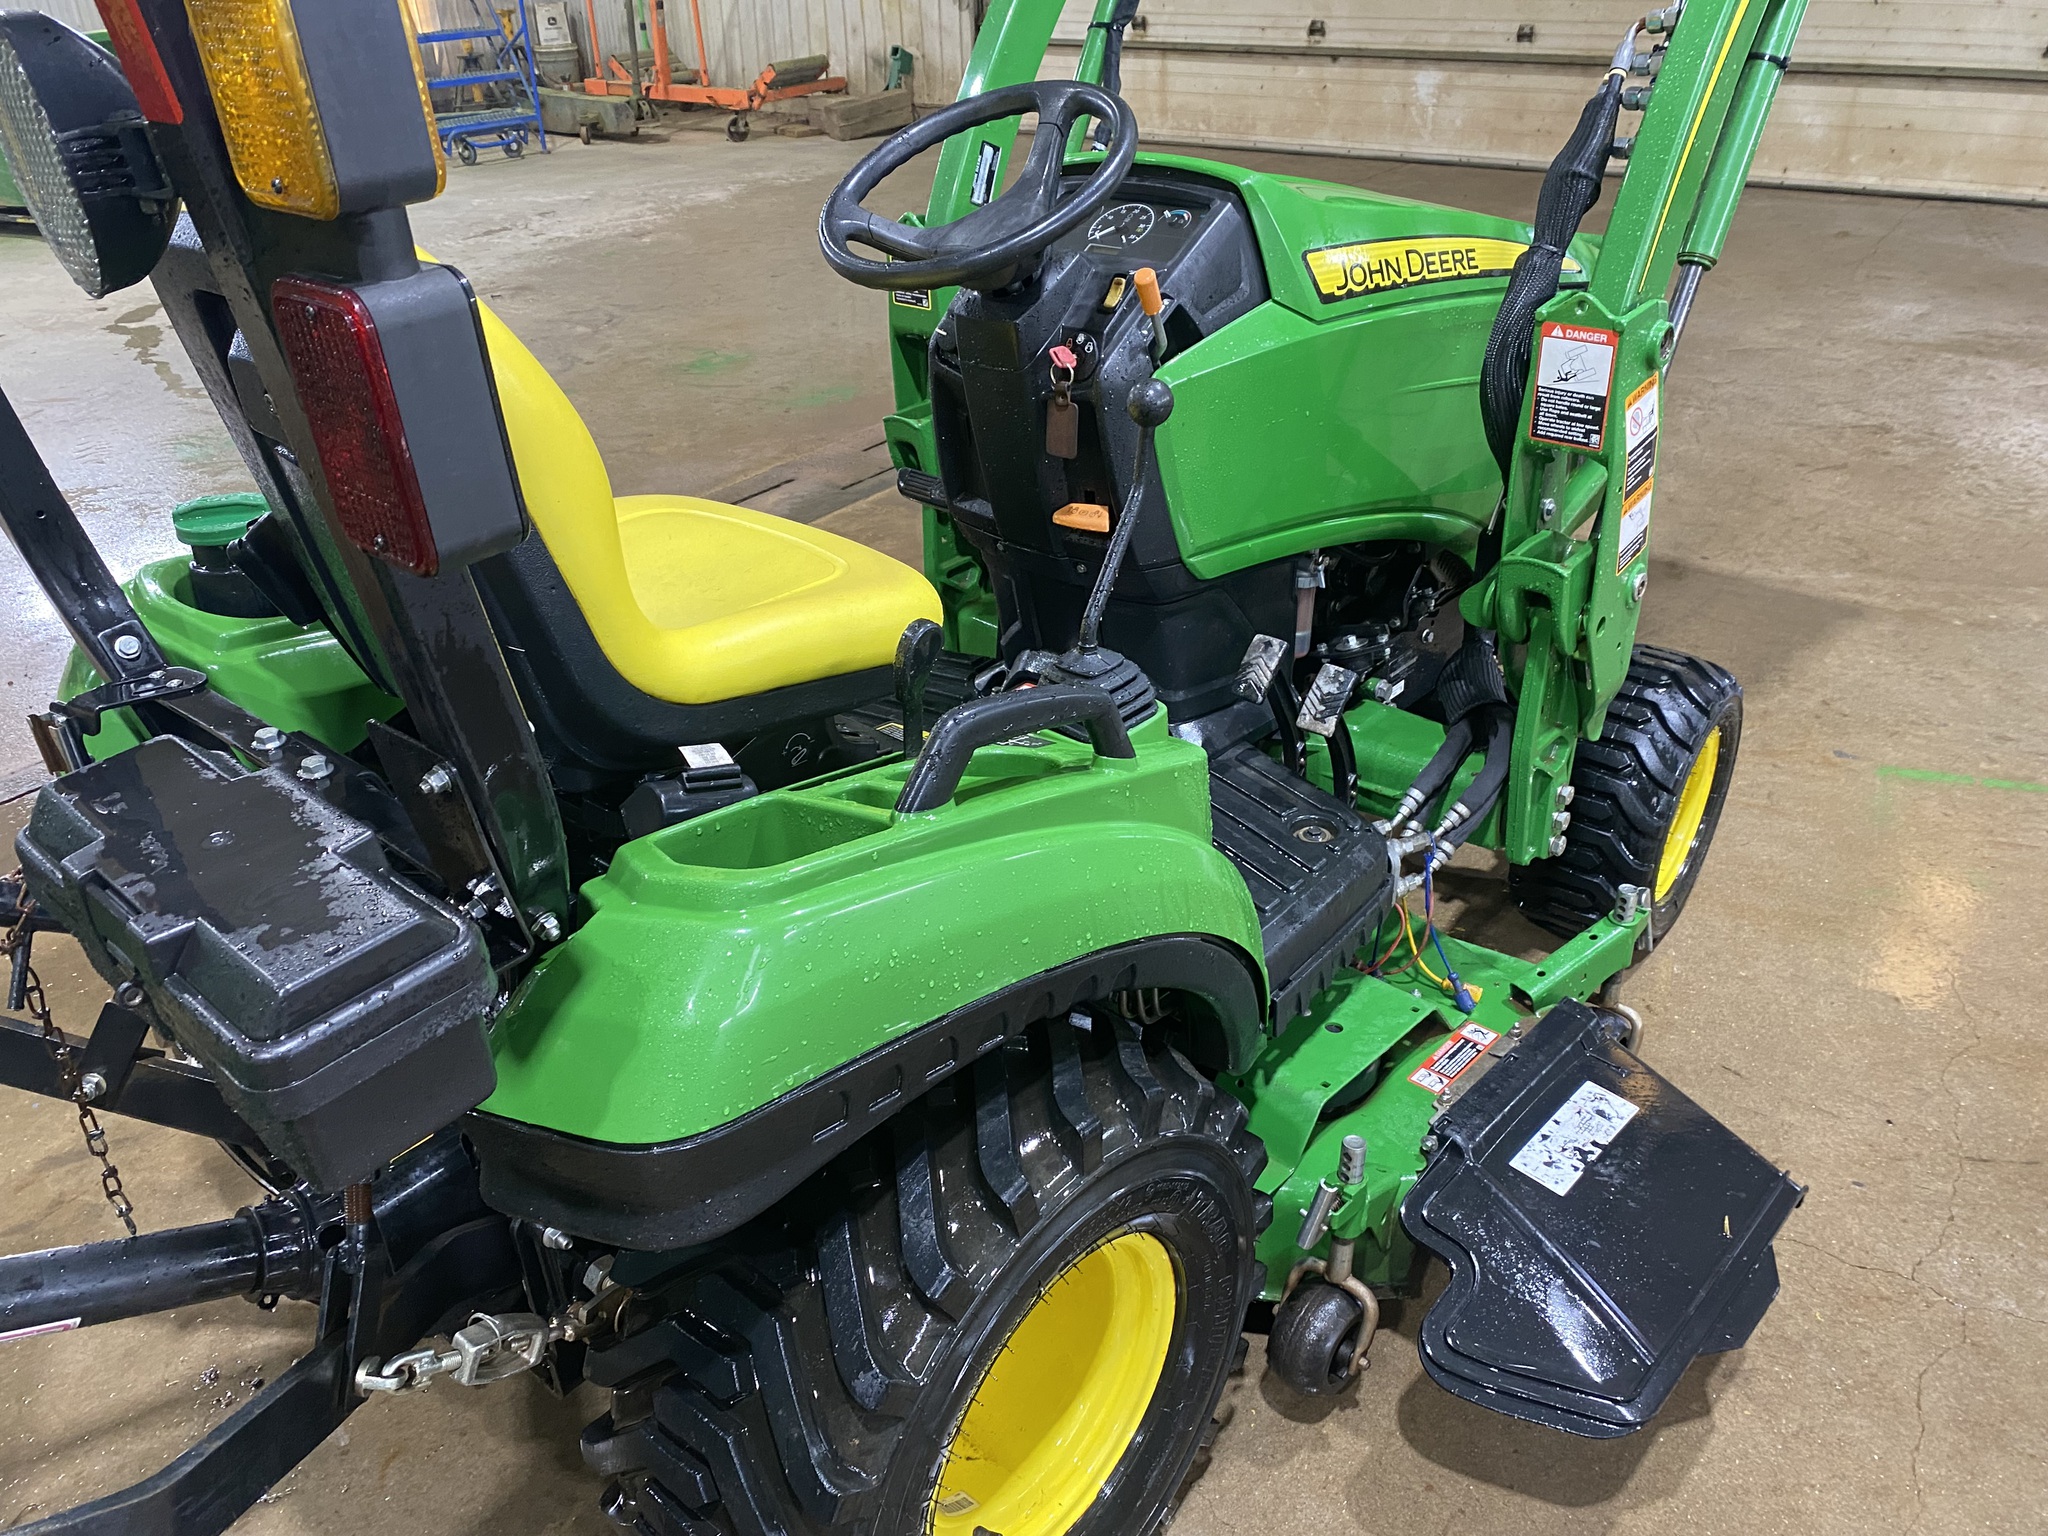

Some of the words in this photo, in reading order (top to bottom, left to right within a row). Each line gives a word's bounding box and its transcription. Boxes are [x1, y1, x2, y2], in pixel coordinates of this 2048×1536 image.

[1336, 256, 1402, 291] JOHN
[1405, 248, 1479, 278] DEERE
[1565, 329, 1608, 343] DANGER
